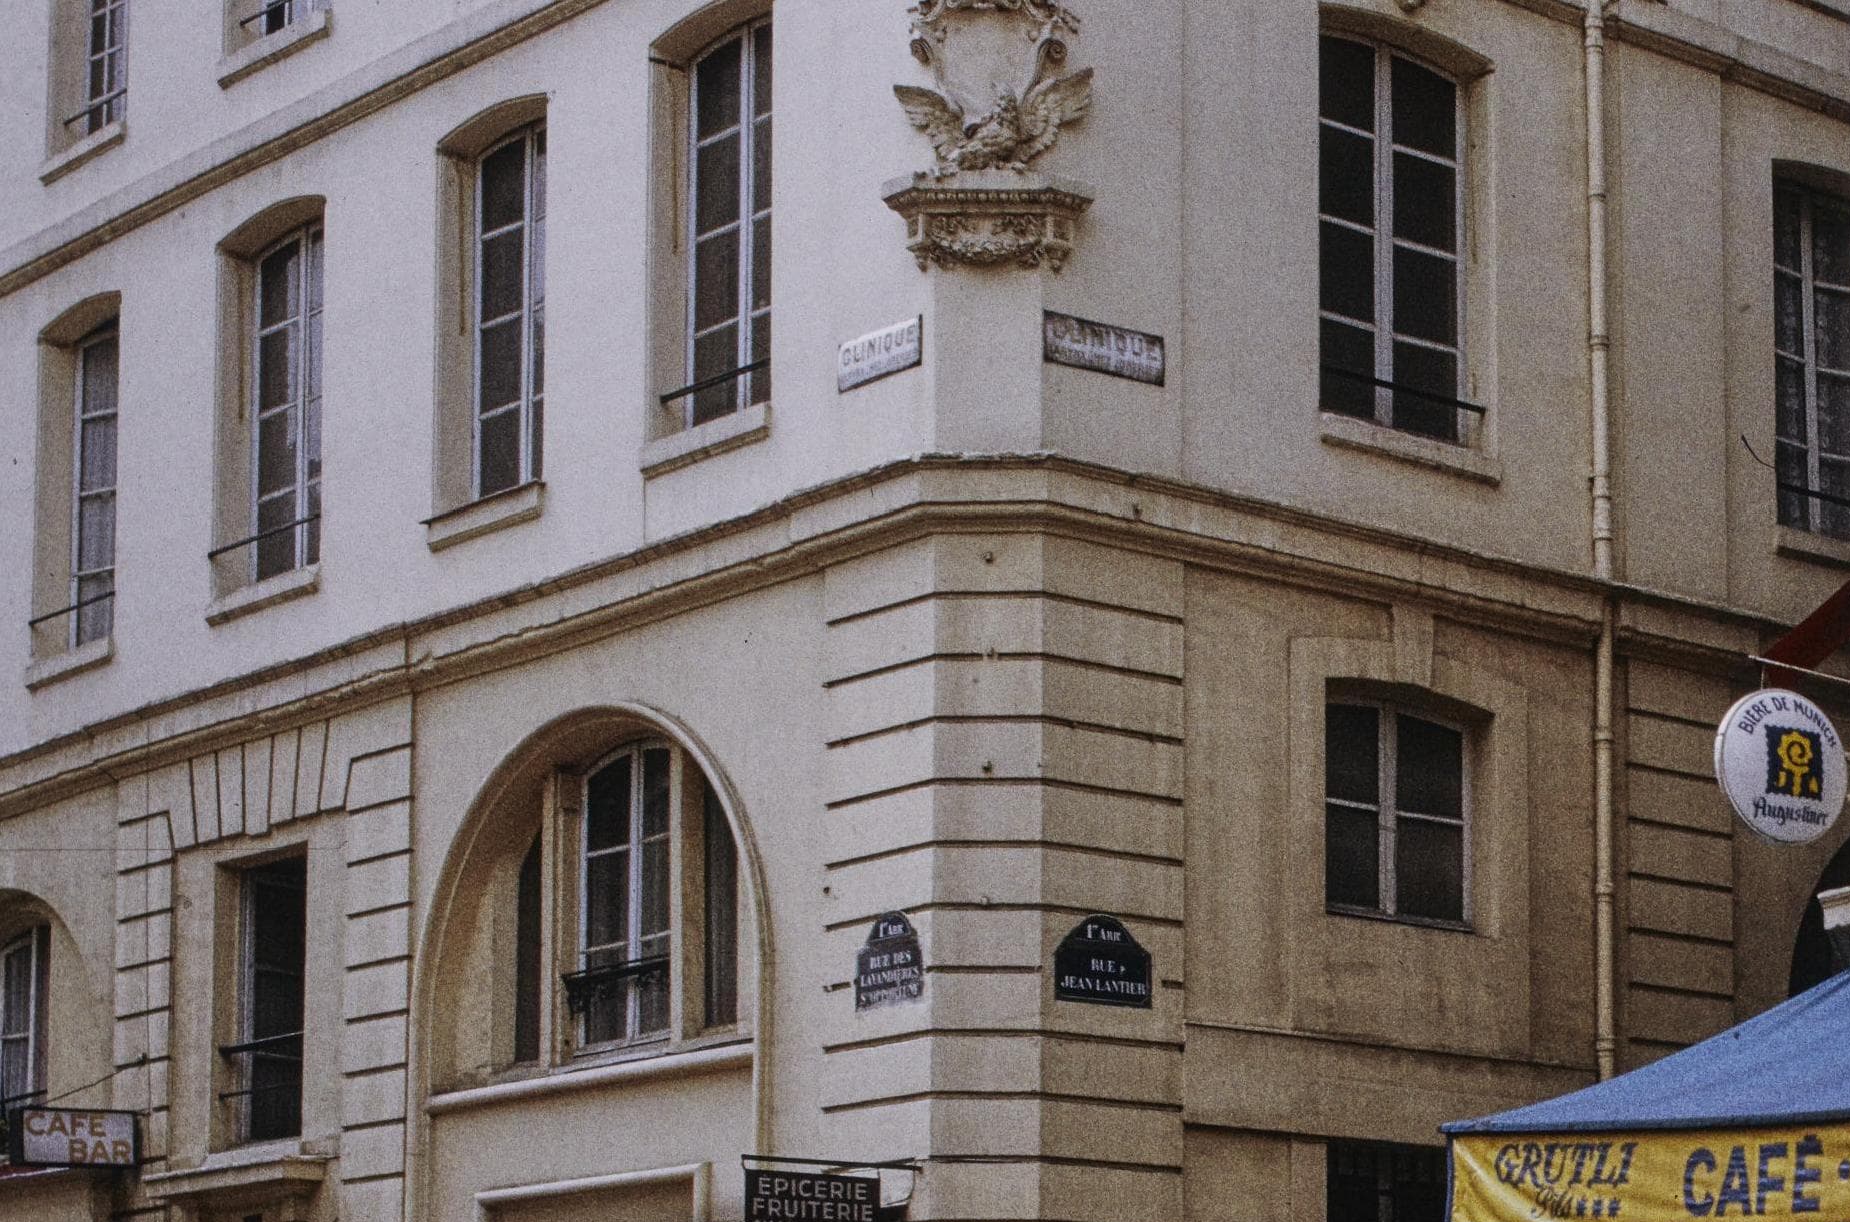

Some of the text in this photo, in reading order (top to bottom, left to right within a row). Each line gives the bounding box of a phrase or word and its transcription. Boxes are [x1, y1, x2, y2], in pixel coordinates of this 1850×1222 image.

[843, 324, 916, 367] CLINIQUE
[1771, 696, 1791, 712] DE
[1793, 698, 1838, 748] MUNICH
[1091, 958, 1116, 973] RUE
[1060, 975, 1147, 996] JEAN LANTIER
[68, 1139, 132, 1163] BAR
[1493, 1141, 1640, 1189] GRUTLI
[752, 1197, 874, 1222] FRUITERIE
